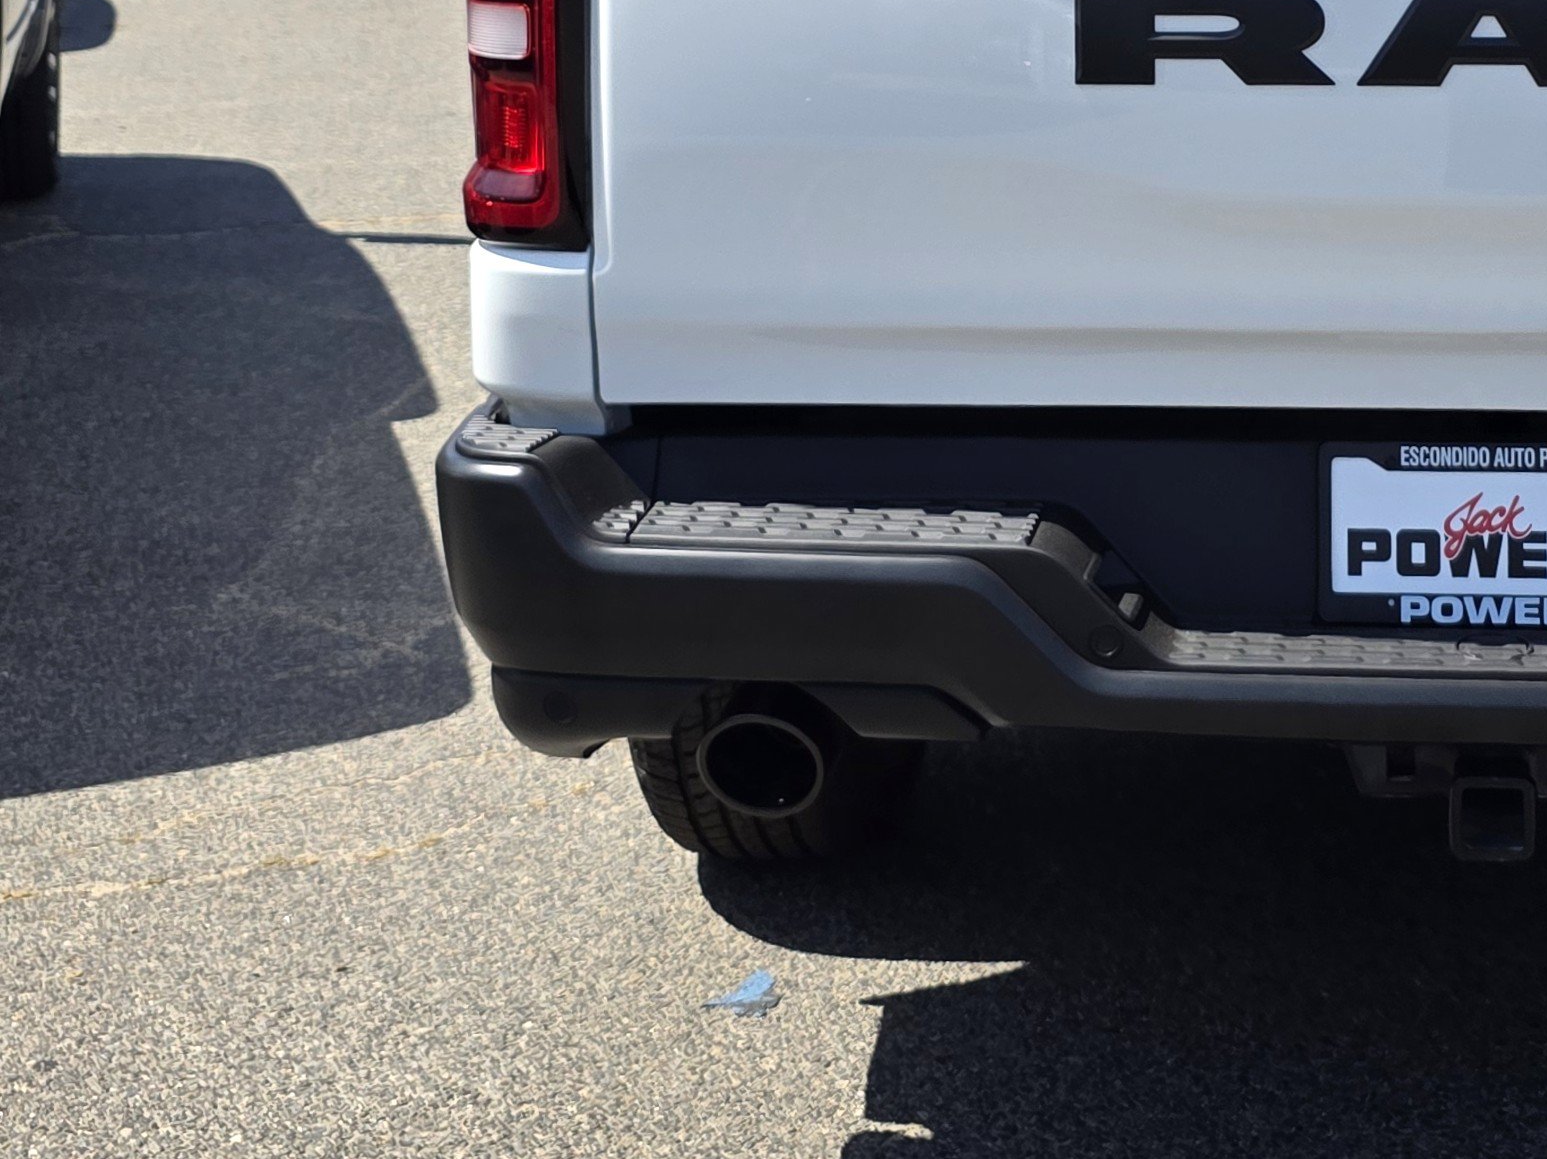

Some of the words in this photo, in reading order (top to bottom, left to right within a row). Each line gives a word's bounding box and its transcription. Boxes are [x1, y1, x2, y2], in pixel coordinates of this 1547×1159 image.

[1400, 445, 1490, 467] ESCONDIDO
[1493, 447, 1536, 468] AUTO
[1443, 492, 1532, 559] Jack
